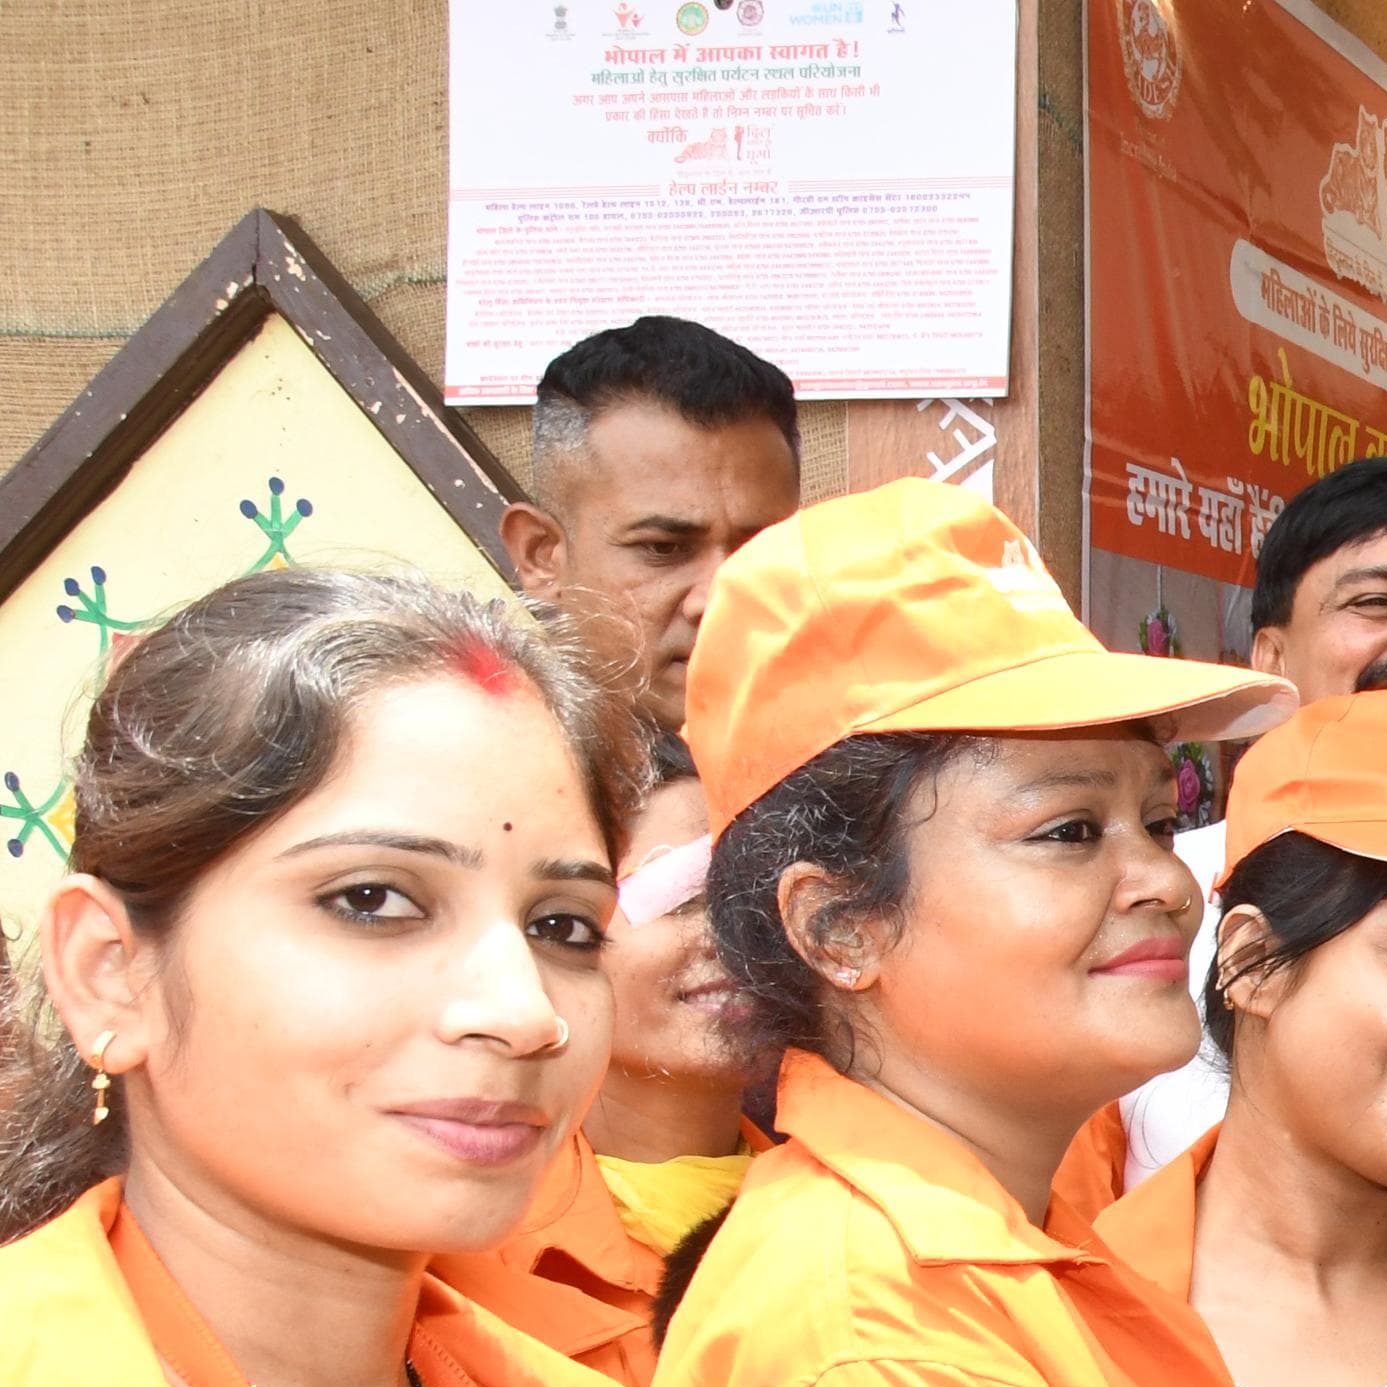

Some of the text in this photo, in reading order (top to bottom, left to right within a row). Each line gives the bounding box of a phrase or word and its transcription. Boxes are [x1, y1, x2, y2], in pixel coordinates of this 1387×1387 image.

[604, 44, 665, 64] भोपाल
[672, 42, 690, 62] में
[695, 46, 762, 62] आपका
[768, 43, 829, 60] स्वागत
[650, 67, 667, 86] हेतु
[671, 66, 717, 87] सुरक्षित
[721, 65, 760, 82] पर्यटन
[764, 66, 795, 81] स्थल
[799, 62, 862, 79] परियोजना
[668, 180, 697, 197] हेल्प
[1260, 267, 1317, 334] महिलाओं
[1318, 295, 1331, 340] के
[1332, 303, 1356, 355] लिये
[1248, 346, 1361, 478] भोपाल
[1125, 457, 1245, 555] हमारे यहाँ
